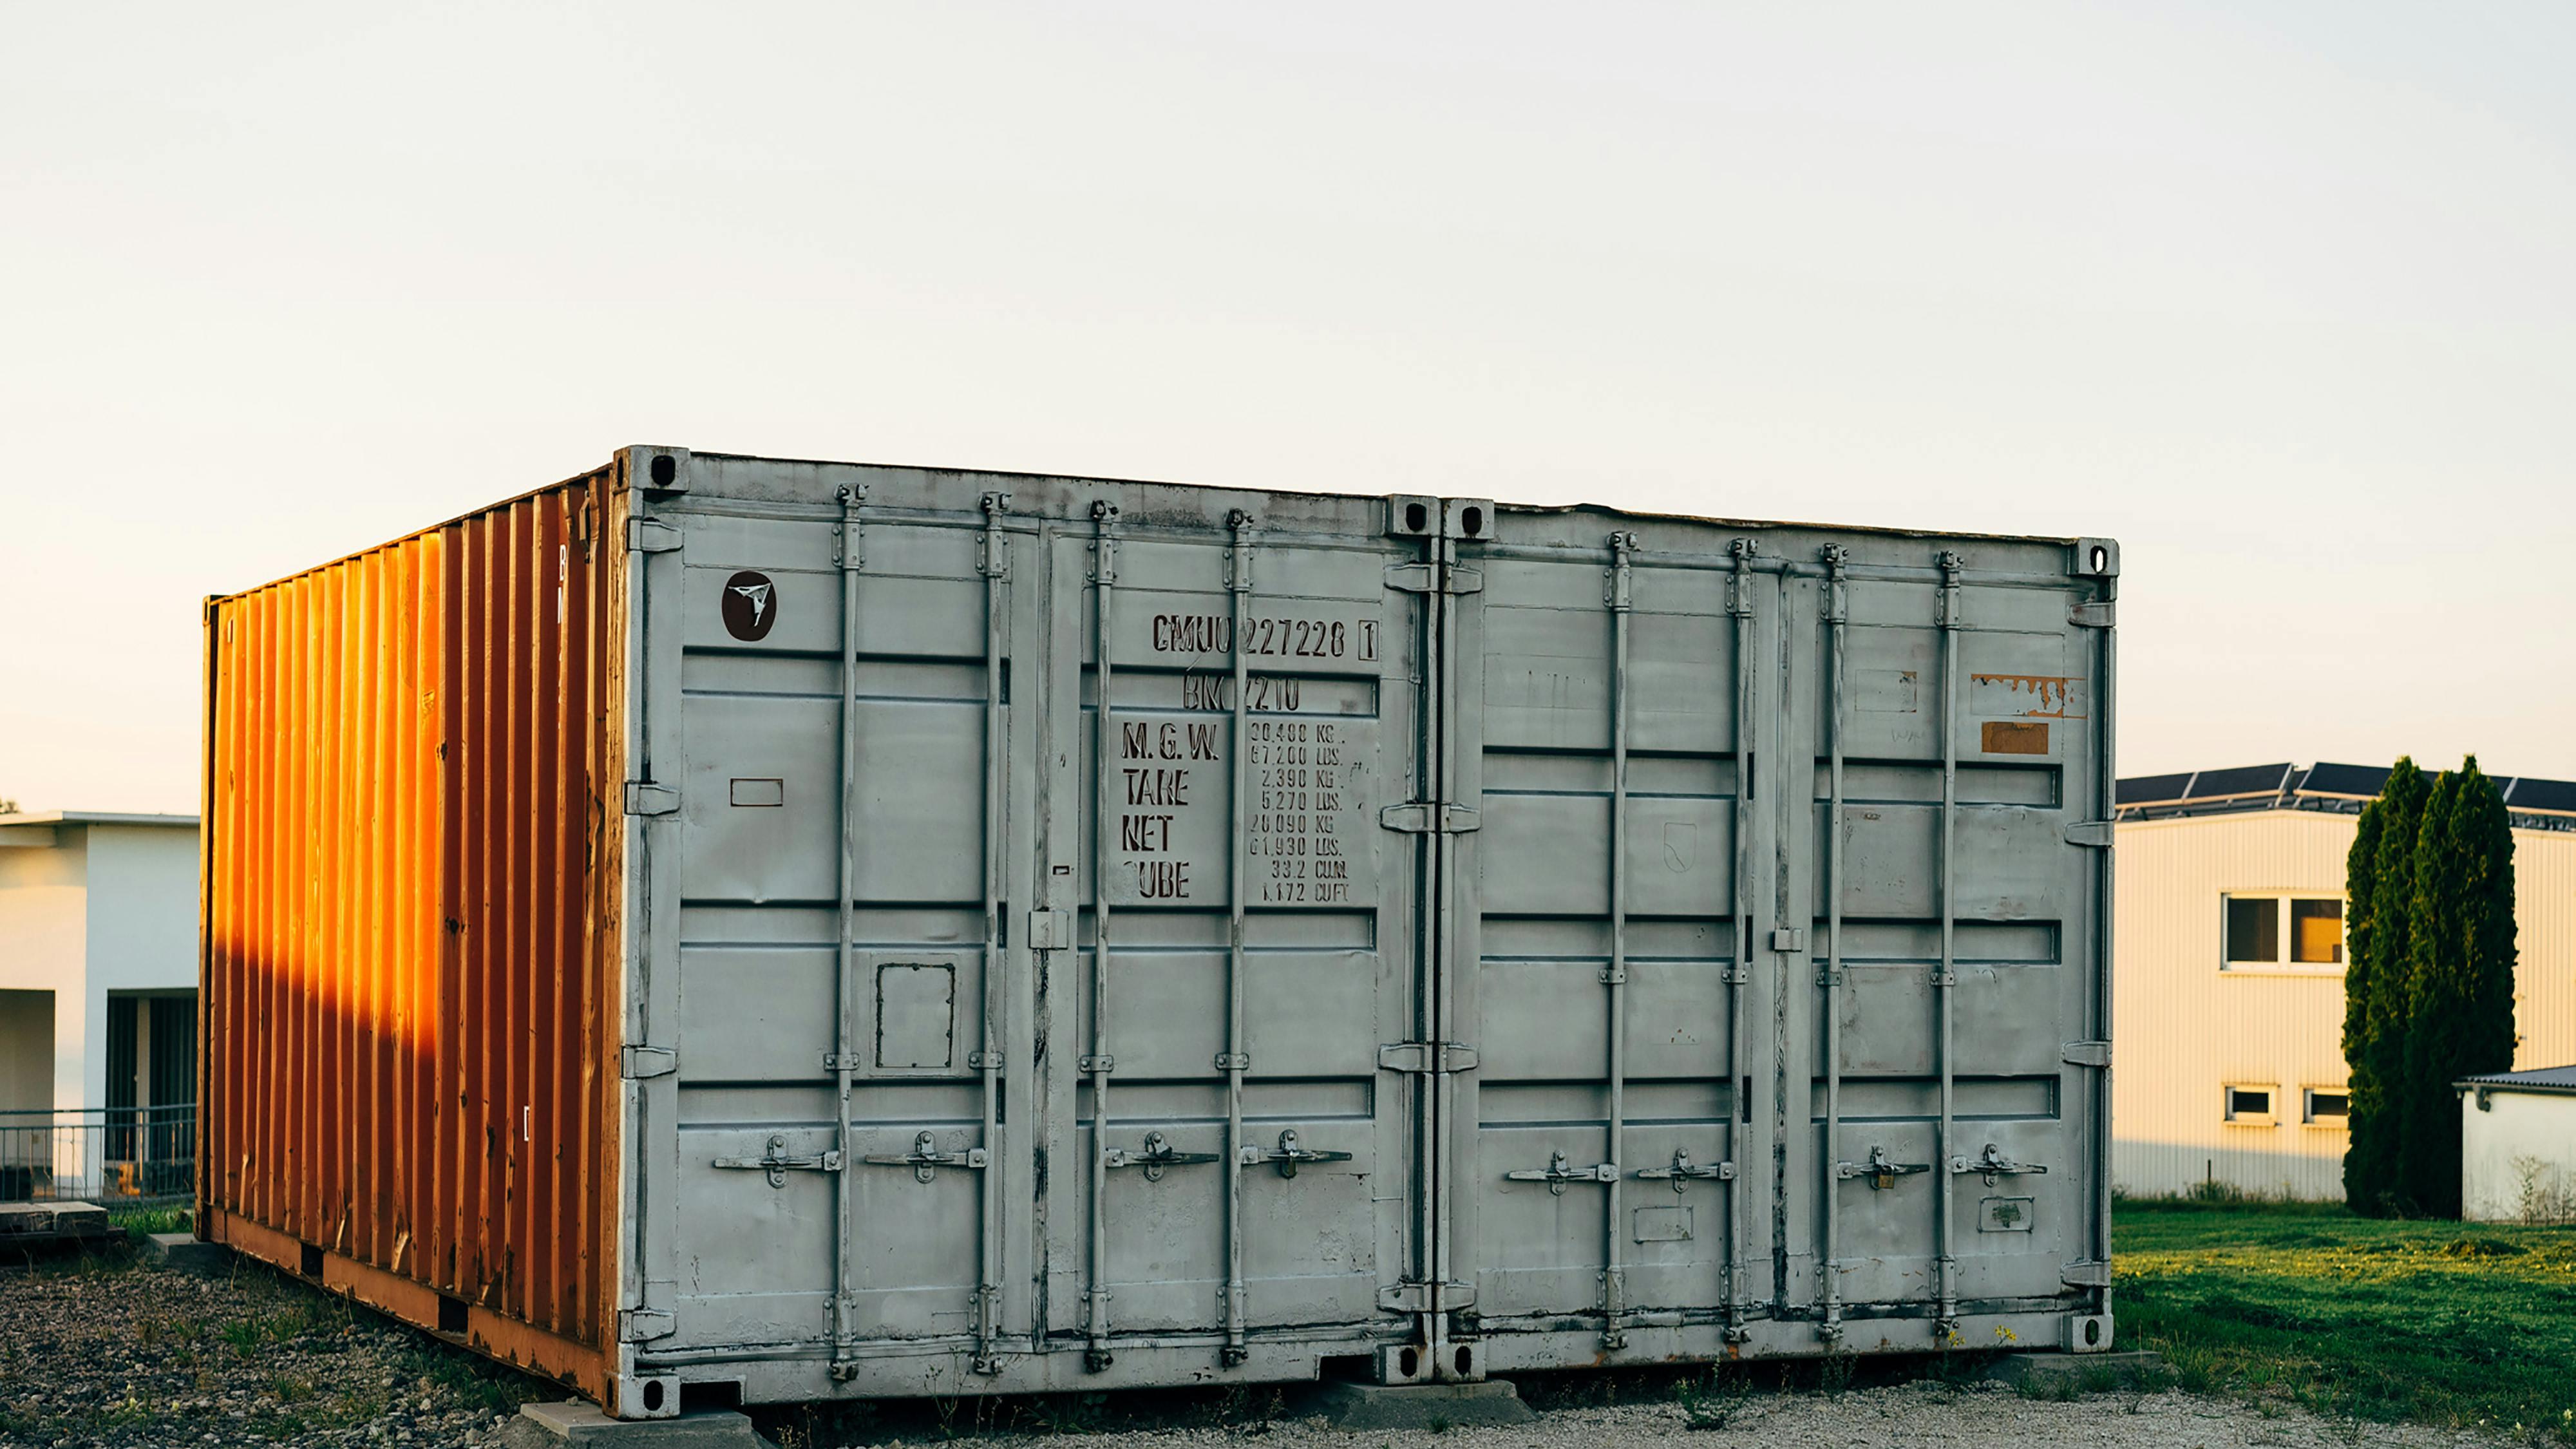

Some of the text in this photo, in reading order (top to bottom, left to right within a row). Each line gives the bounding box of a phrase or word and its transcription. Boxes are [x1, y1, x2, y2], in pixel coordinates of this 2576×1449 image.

[1153, 614, 1232, 653] CMUU
[1246, 618, 1345, 657] 227228
[1122, 769, 1189, 805] TARE
[1122, 815, 1173, 851] NET
[1124, 860, 1189, 898] UBE
[1272, 860, 1305, 878] 33.2
